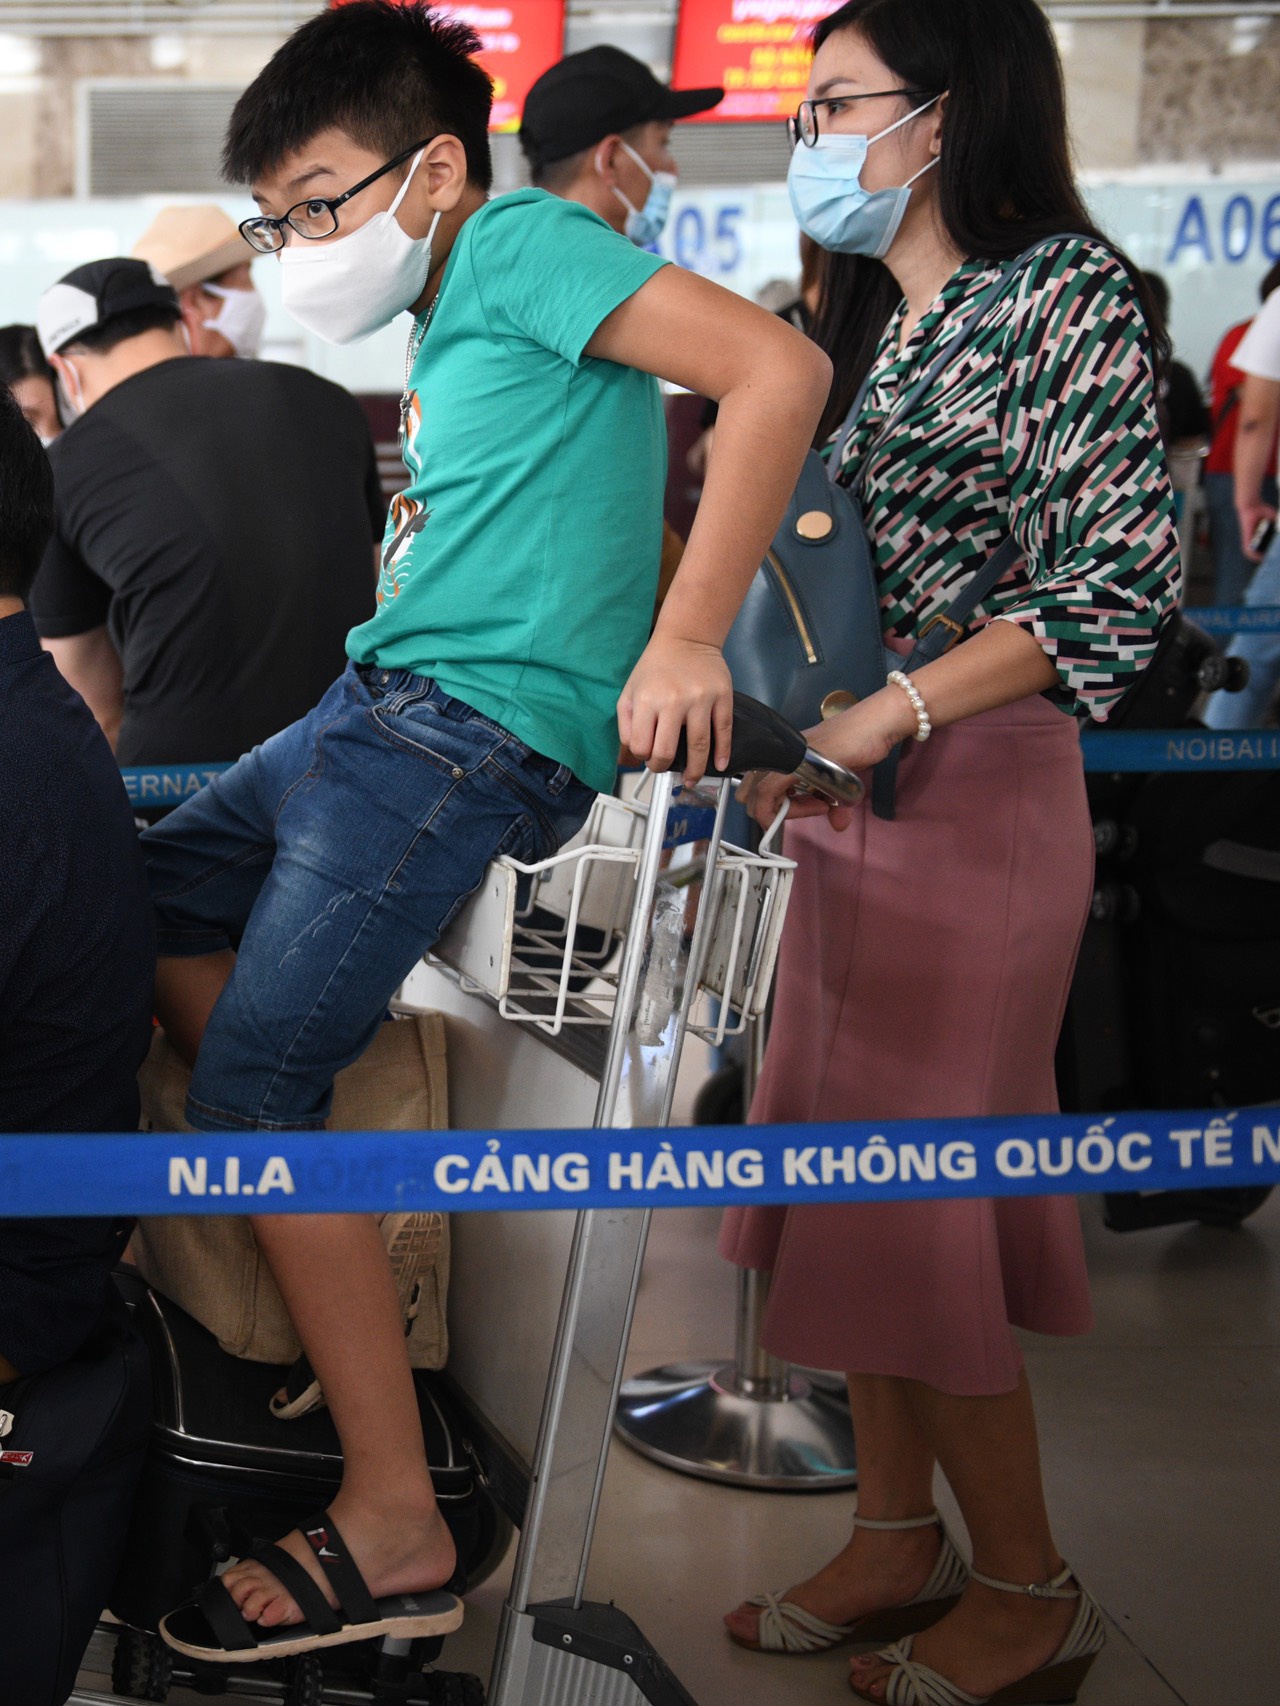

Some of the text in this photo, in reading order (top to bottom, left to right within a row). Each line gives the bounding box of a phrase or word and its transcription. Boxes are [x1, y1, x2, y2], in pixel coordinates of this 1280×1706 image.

[1169, 738, 1263, 761] NOIBAI
[168, 1155, 296, 1196] N.I.A
[433, 1138, 590, 1195] CẢNG
[607, 1141, 765, 1191] HÀNG
[782, 1134, 977, 1187] KHÔNG
[995, 1118, 1153, 1178] QUỐC
[1169, 1111, 1239, 1169] TẾ
